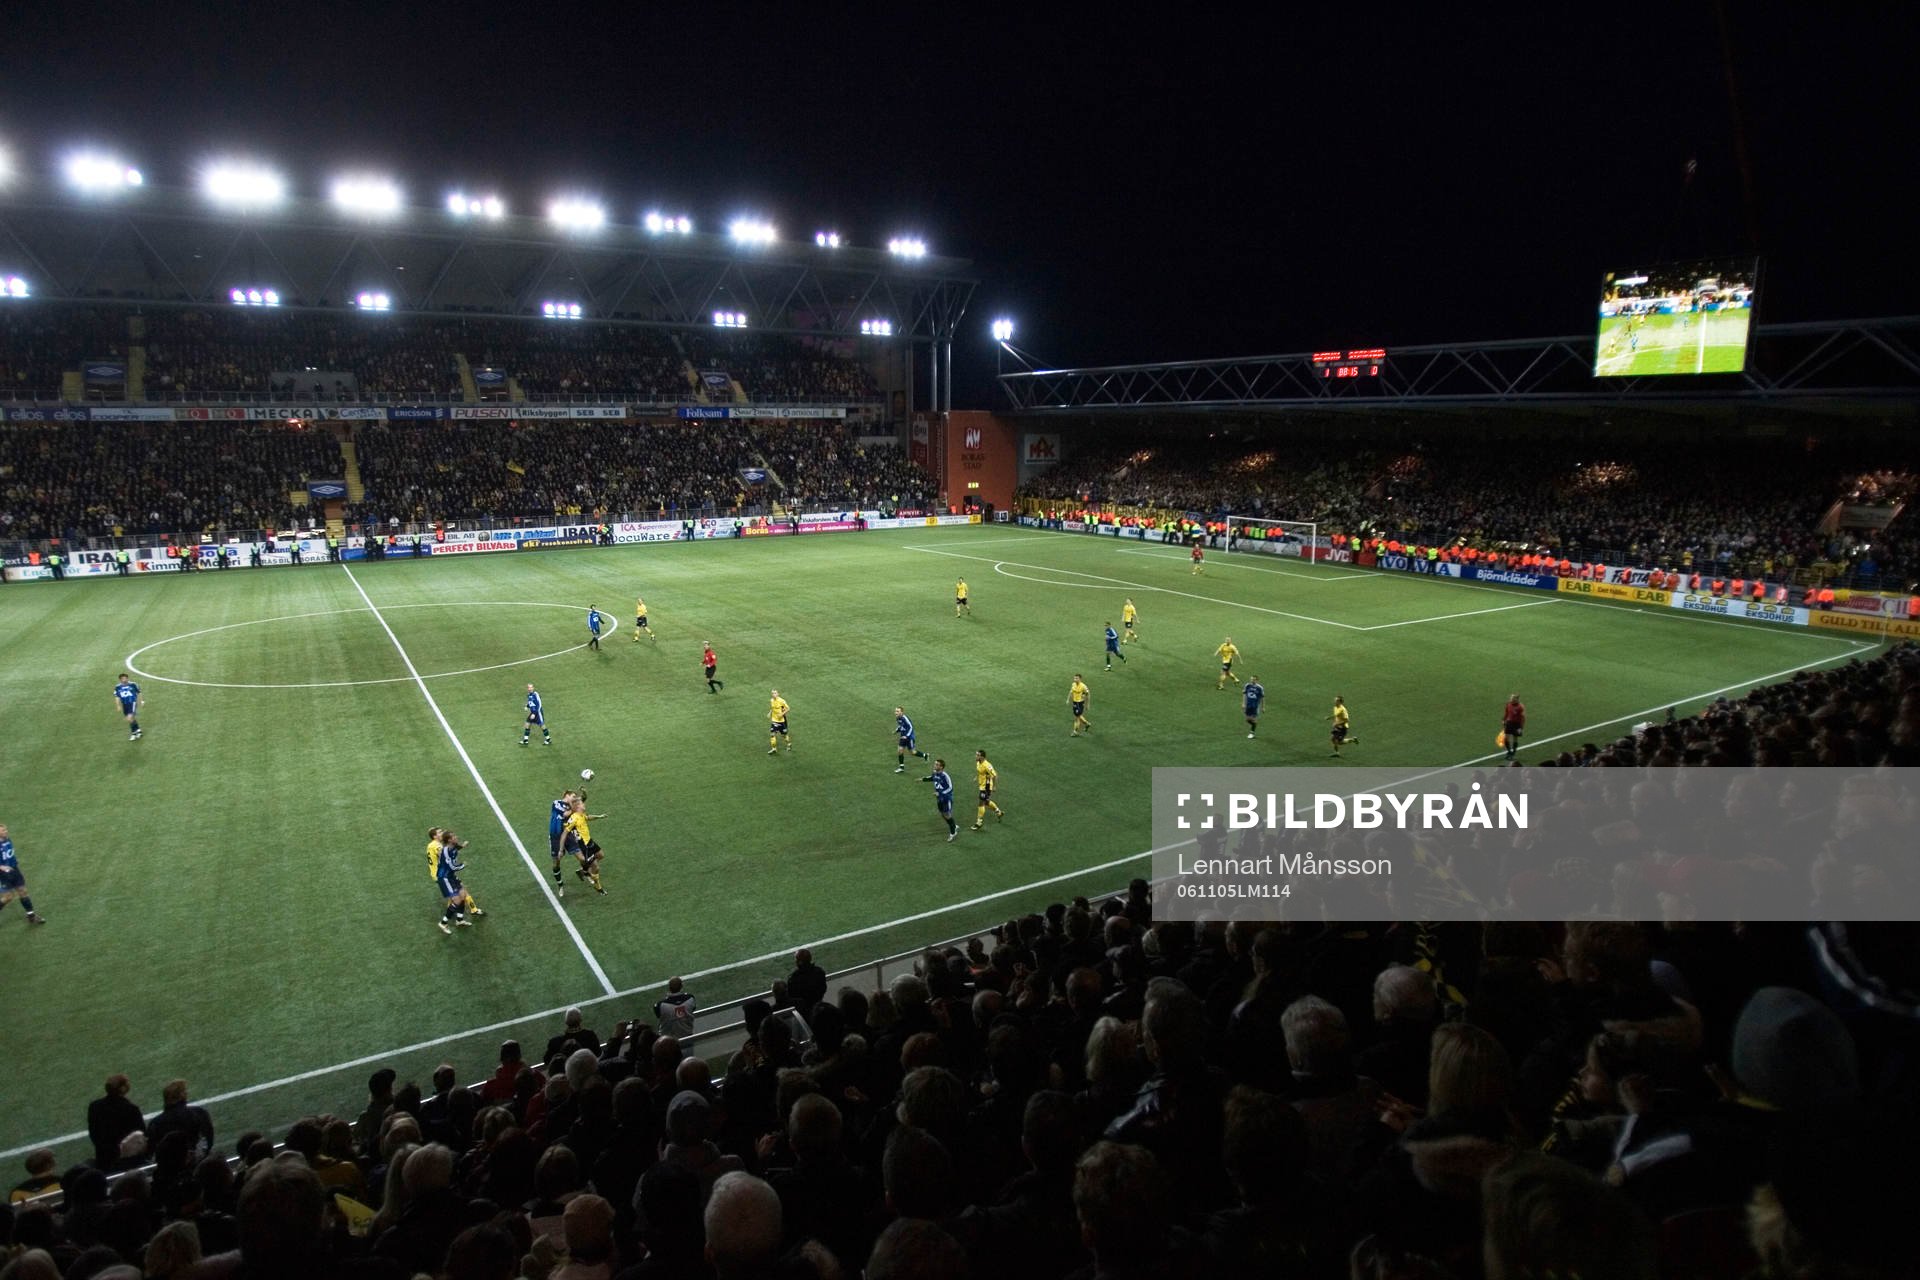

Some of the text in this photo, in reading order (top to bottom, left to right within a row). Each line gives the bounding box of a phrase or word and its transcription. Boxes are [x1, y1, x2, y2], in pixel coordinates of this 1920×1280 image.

[11, 409, 44, 420] ellos
[54, 409, 87, 420] ellos
[254, 408, 313, 418] MECKA
[455, 408, 509, 418] PULSEN
[522, 408, 567, 418] Riksbyggen
[576, 409, 595, 417] SEB
[603, 409, 621, 417] SEB
[686, 407, 723, 418] Folksam
[621, 523, 636, 531] ICA
[433, 543, 473, 553] PERFECT
[1325, 549, 1350, 562] JVC
[1384, 556, 1451, 576] VOVA
[1476, 569, 1540, 586] Björnkläder
[1565, 580, 1591, 592] EAB
[1636, 591, 1665, 602] EAB
[1820, 615, 1858, 627] GULD
